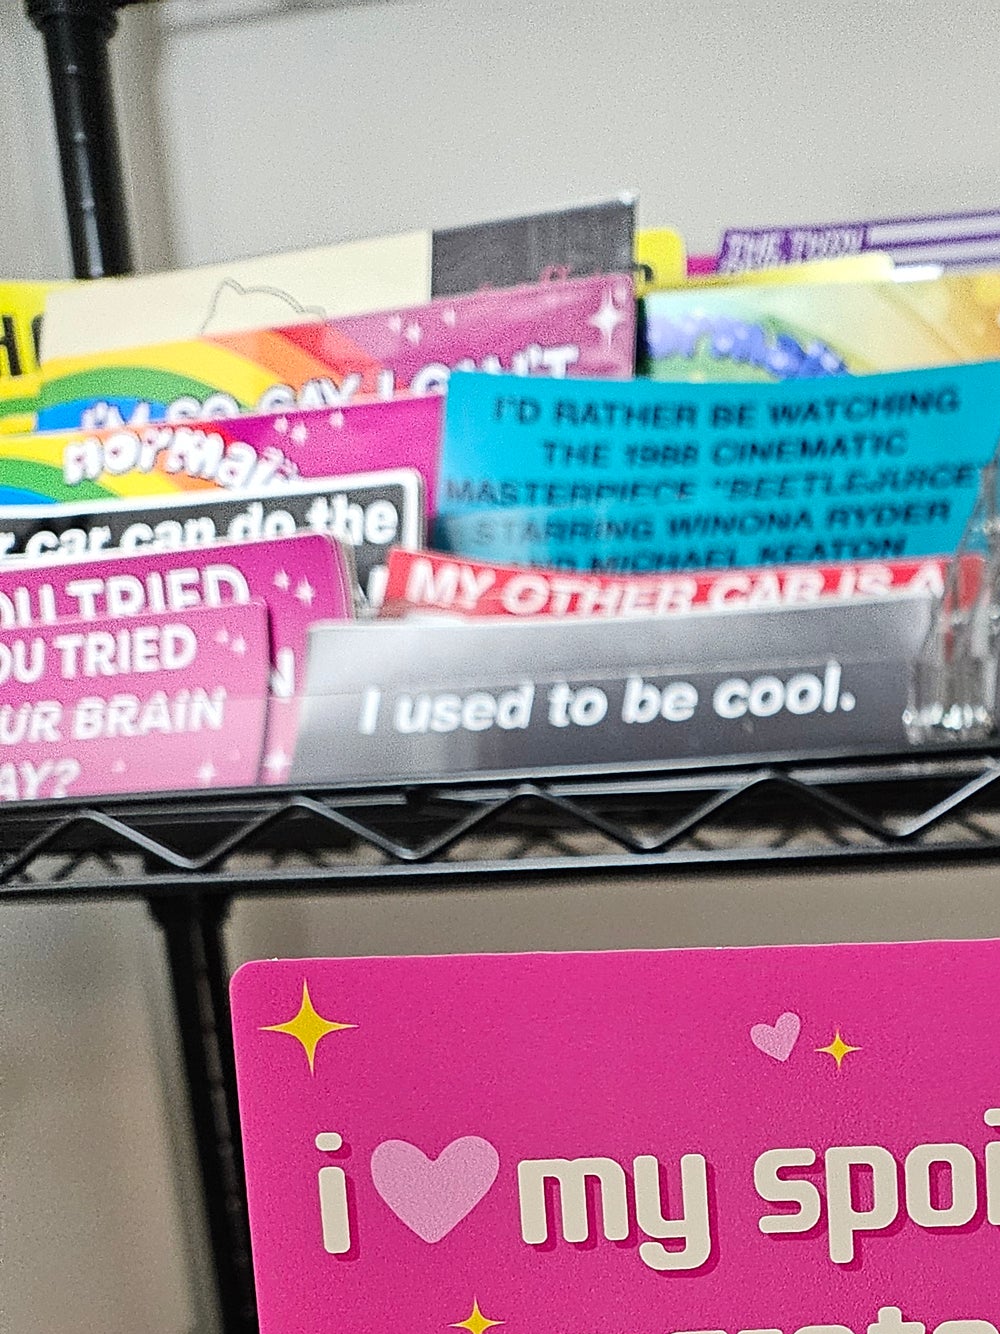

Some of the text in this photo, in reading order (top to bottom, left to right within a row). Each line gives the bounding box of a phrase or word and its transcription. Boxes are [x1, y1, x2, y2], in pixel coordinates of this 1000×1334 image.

[555, 398, 697, 428] RATHER
[711, 402, 757, 429] BE
[768, 385, 961, 425] WATCHING
[543, 439, 610, 468] THE
[711, 429, 908, 467] CINEMATIC
[228, 501, 297, 541] do
[304, 494, 399, 546] the
[668, 510, 813, 536] WINONA
[825, 500, 950, 528] RYDER
[65, 563, 251, 620] TRIED
[406, 558, 497, 610] MY
[502, 573, 698, 617] OTHER
[706, 568, 826, 606] CAR
[838, 563, 894, 598] IS
[904, 561, 945, 598] A
[54, 623, 198, 680] TRIED
[72, 685, 228, 741] BRAIN
[358, 660, 857, 735] I used to be cool.
[314, 1132, 352, 1255] i
[517, 1153, 713, 1272] my
